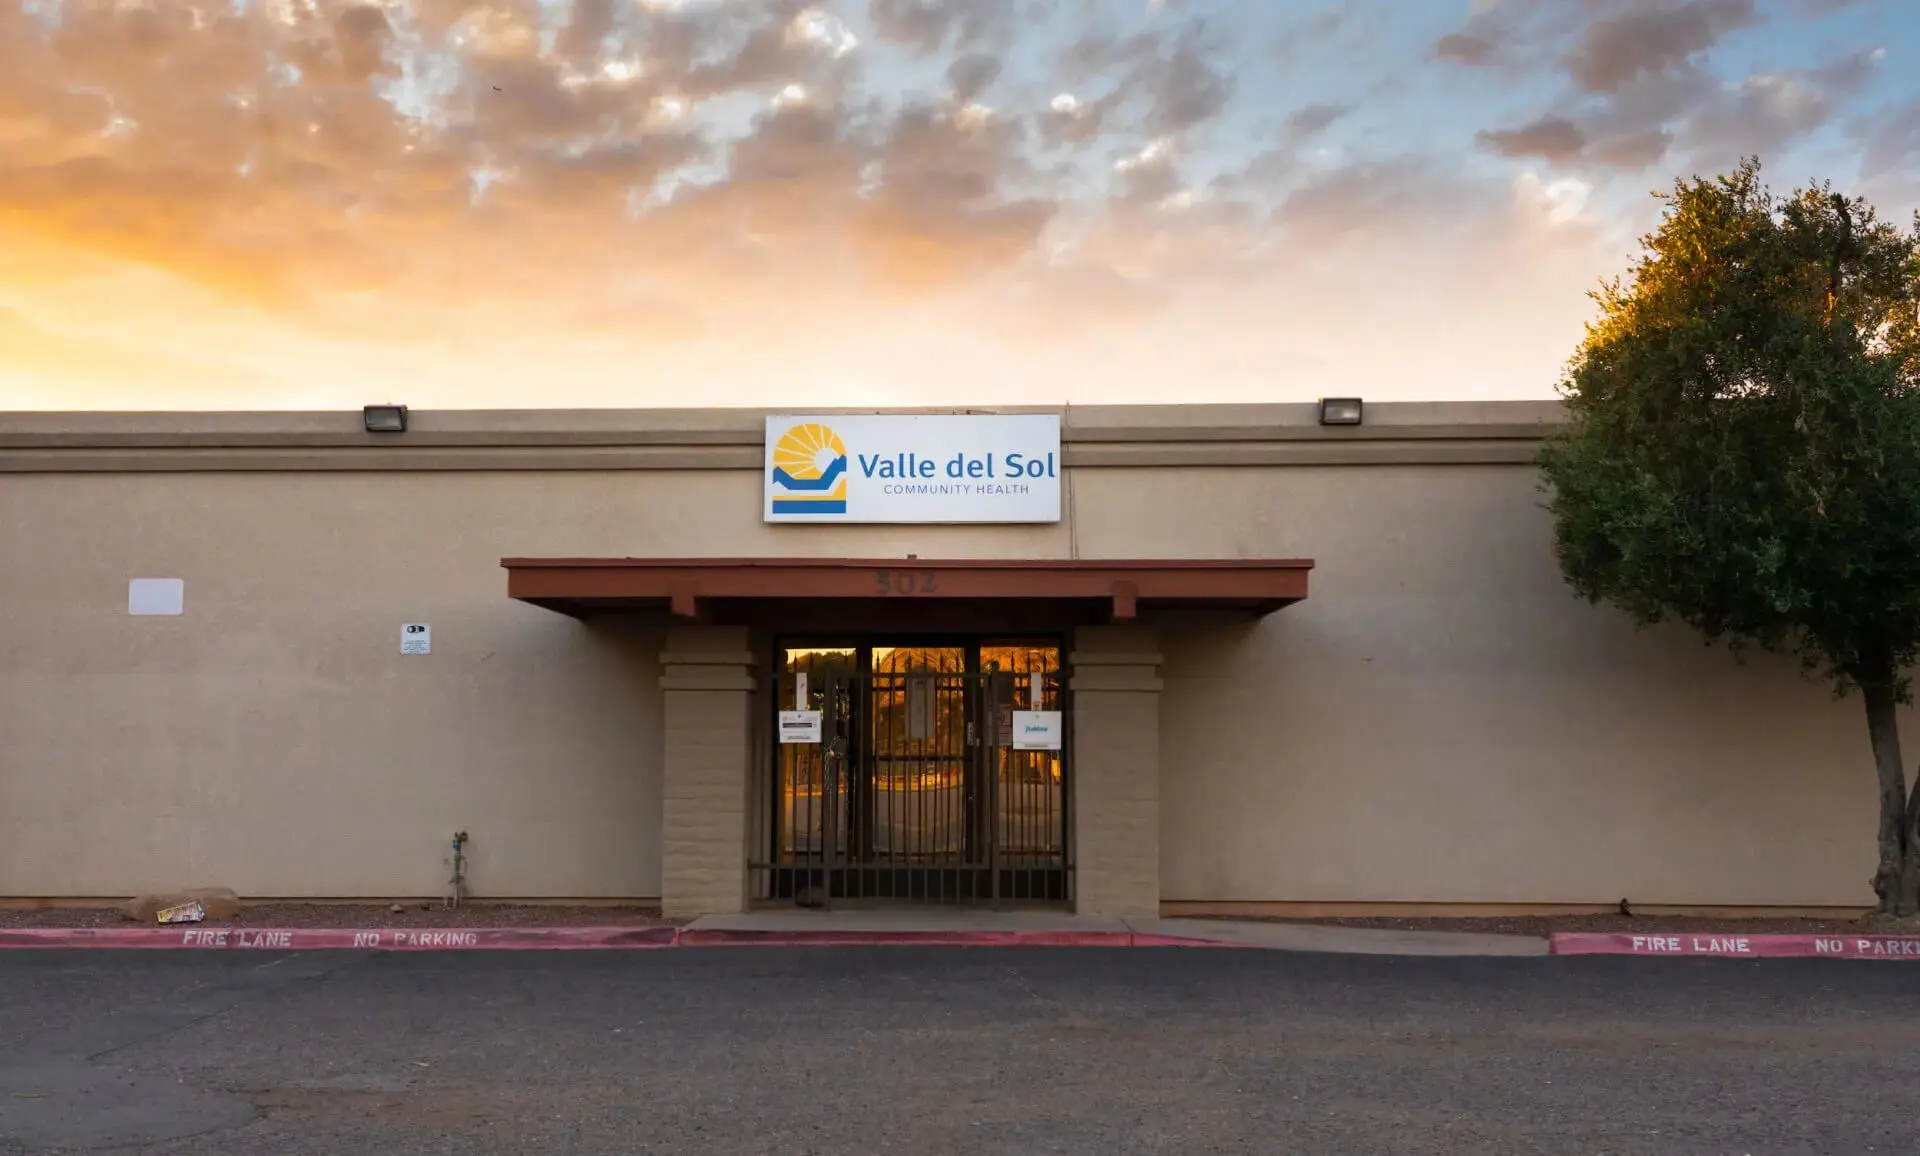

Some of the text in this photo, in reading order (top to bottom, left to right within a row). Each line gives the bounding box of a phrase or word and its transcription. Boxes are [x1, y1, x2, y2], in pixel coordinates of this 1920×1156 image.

[858, 452, 1056, 478] Valle del Sol
[884, 484, 1030, 495] COMMUNITY HEALTH
[182, 930, 292, 947] FIRE LANE
[353, 932, 477, 948] NO PARKING
[1632, 936, 1750, 953] FIRE LANE
[1815, 938, 1844, 953] NO
